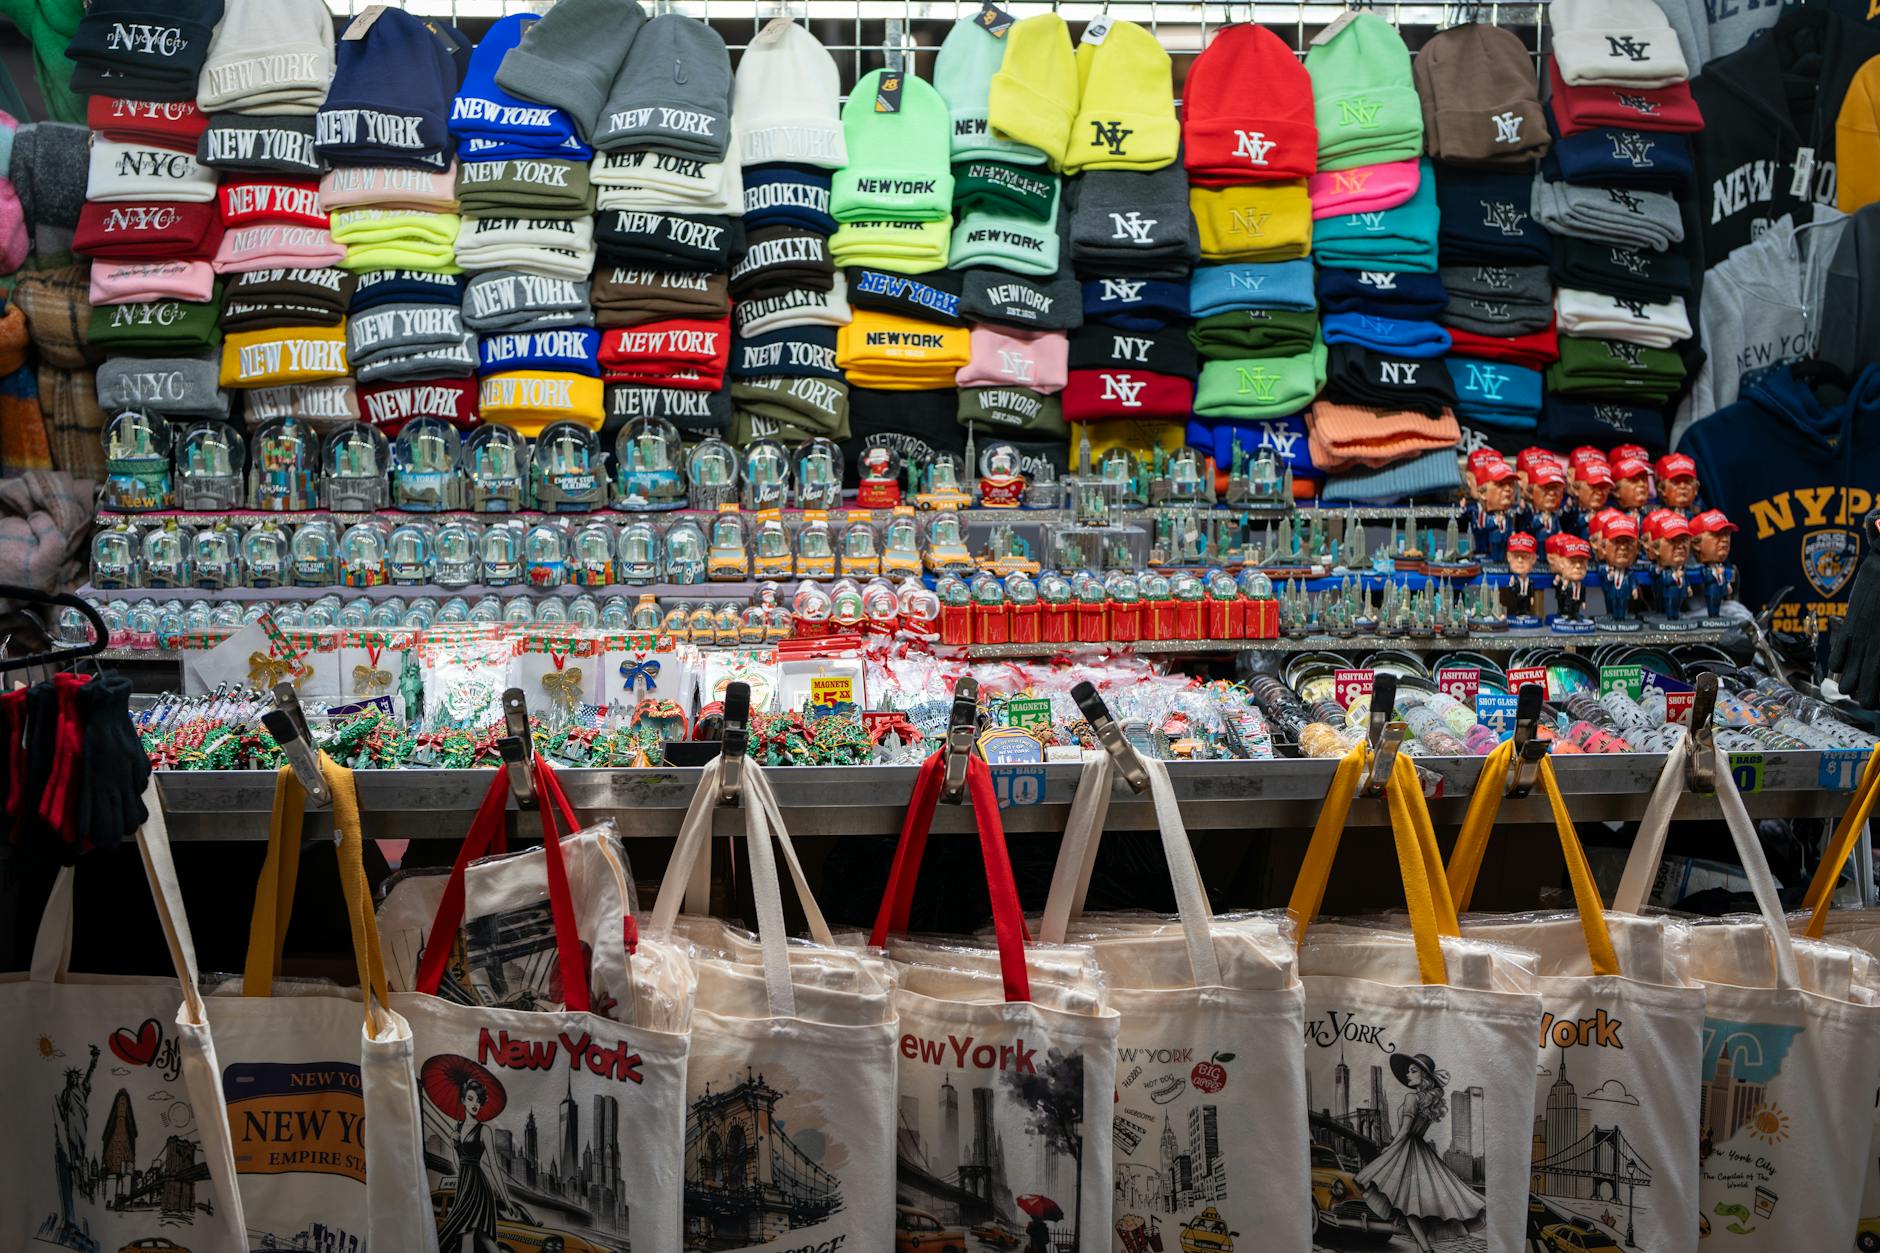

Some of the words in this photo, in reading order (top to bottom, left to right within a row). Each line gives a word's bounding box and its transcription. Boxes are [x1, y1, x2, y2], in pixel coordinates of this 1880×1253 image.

[108, 23, 181, 56] NYC
[1605, 36, 1650, 61] NY
[208, 61, 257, 98] NEW
[258, 53, 319, 84] YORK
[451, 97, 498, 122] NEW
[499, 106, 558, 127] YORK
[608, 108, 655, 133] NEW
[659, 108, 716, 136] YORK
[1338, 96, 1383, 129] NY
[315, 110, 360, 146] NEW
[360, 110, 424, 149] YORK
[1091, 121, 1134, 155] NY
[1492, 112, 1523, 144] NY
[207, 128, 259, 161] NEW
[260, 129, 320, 168] YORK
[1232, 129, 1276, 165] NY
[1606, 131, 1655, 167] NY
[119, 151, 189, 178] NYC
[462, 161, 507, 185] NEW
[513, 160, 571, 187] YORK
[604, 152, 647, 168] NEW
[654, 152, 706, 179] YORK
[332, 169, 377, 192] NEW
[1330, 169, 1374, 195] NY
[1711, 160, 1774, 225] NEW
[228, 185, 274, 216] NEW
[274, 185, 327, 220] YORK
[1609, 187, 1644, 215] NY
[105, 207, 175, 232] NYC
[615, 211, 661, 233] NEW
[667, 217, 725, 251] YORK
[1108, 211, 1158, 243] NY
[1228, 207, 1271, 237] NY
[1480, 200, 1527, 236] NY
[232, 230, 273, 254] NEW
[278, 228, 326, 247] YORK
[610, 268, 656, 285] NEW
[661, 272, 712, 291] YORK
[858, 271, 907, 297] NEW
[909, 279, 961, 317] YORK
[1099, 278, 1147, 302] NY
[1225, 269, 1271, 293] NY
[471, 278, 517, 319] NEW
[518, 276, 582, 306] YORK
[112, 303, 179, 327] NYC
[352, 315, 399, 351] NEW
[398, 307, 460, 337] YORK
[1360, 315, 1395, 338] NY
[486, 335, 532, 363] NEW
[534, 331, 589, 358] YORK
[619, 332, 667, 353] NEW
[668, 330, 718, 355] YORK
[743, 342, 784, 369] NEW
[786, 342, 839, 372] YORK
[1112, 336, 1154, 362] NY
[239, 342, 283, 379] NEW
[284, 340, 346, 372] YORK
[997, 350, 1034, 382] NY
[1380, 361, 1420, 384] NY
[118, 371, 184, 401] NYC
[479, 378, 519, 407] NEW
[519, 379, 574, 408] YORK
[788, 378, 843, 415] YORK
[1099, 374, 1147, 407] NY
[1236, 367, 1281, 401] NY
[1465, 364, 1509, 400] NY
[252, 386, 292, 420] NEW
[296, 385, 352, 418] YORK
[365, 389, 414, 424] NEW
[413, 386, 464, 419] YORK
[614, 389, 662, 416] NEW
[663, 390, 711, 416] YORK
[1258, 422, 1302, 457] NY
[1337, 672, 1374, 681] ASHTRAY
[1442, 672, 1477, 680] ASHTRAY
[1509, 670, 1545, 680] ASHTRAY
[1603, 669, 1639, 677] ASHTRAY
[1011, 702, 1048, 712] MAGNETS
[1669, 696, 1686, 704] SHOT
[1824, 752, 1857, 760] TOTES
[478, 1027, 557, 1070] New
[558, 1031, 644, 1085] York
[1145, 1048, 1194, 1063] YORK
[289, 1072, 335, 1087] NEW
[1198, 1064, 1220, 1080] BIG
[242, 1110, 331, 1142] NEW
[269, 1151, 342, 1165] EMPIRE
[1729, 1150, 1752, 1162] York
[1718, 1172, 1744, 1181] Capital
[1757, 1173, 1769, 1181] The
